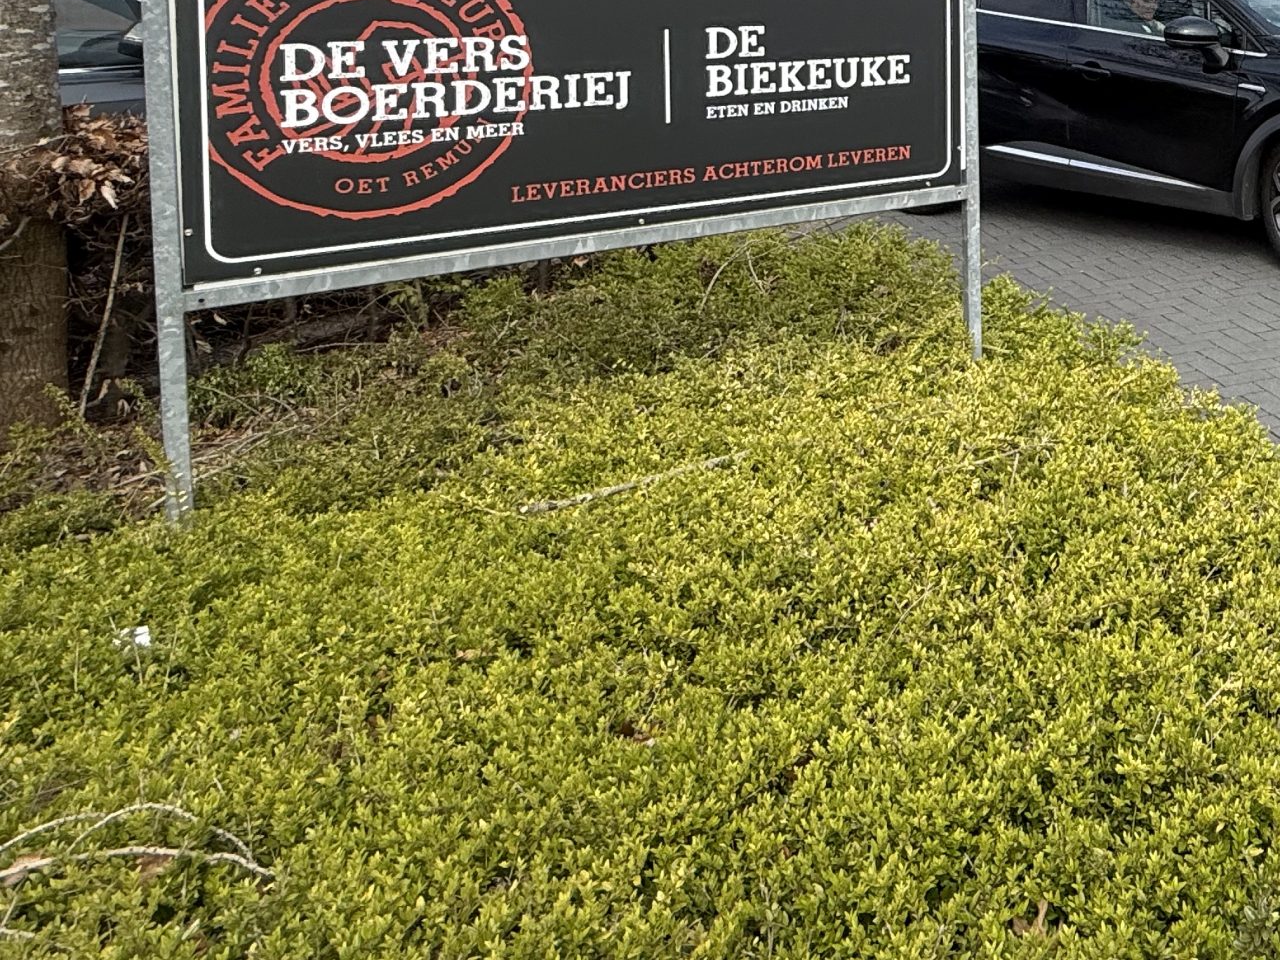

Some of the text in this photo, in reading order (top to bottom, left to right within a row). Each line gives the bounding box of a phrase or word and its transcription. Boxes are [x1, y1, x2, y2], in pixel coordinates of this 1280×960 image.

[279, 34, 530, 82] DE VERS
[705, 24, 766, 60] DE
[705, 54, 911, 98] BIEKEUKE
[279, 70, 632, 128] BOERDERIEJ
[706, 95, 849, 120] ETEN EN DRINKEN
[281, 122, 525, 155] VERS, VLEES EN MEER
[334, 176, 390, 195] OET
[511, 144, 912, 204] LEVERANCIERS ACHTEROM LEVEREN
